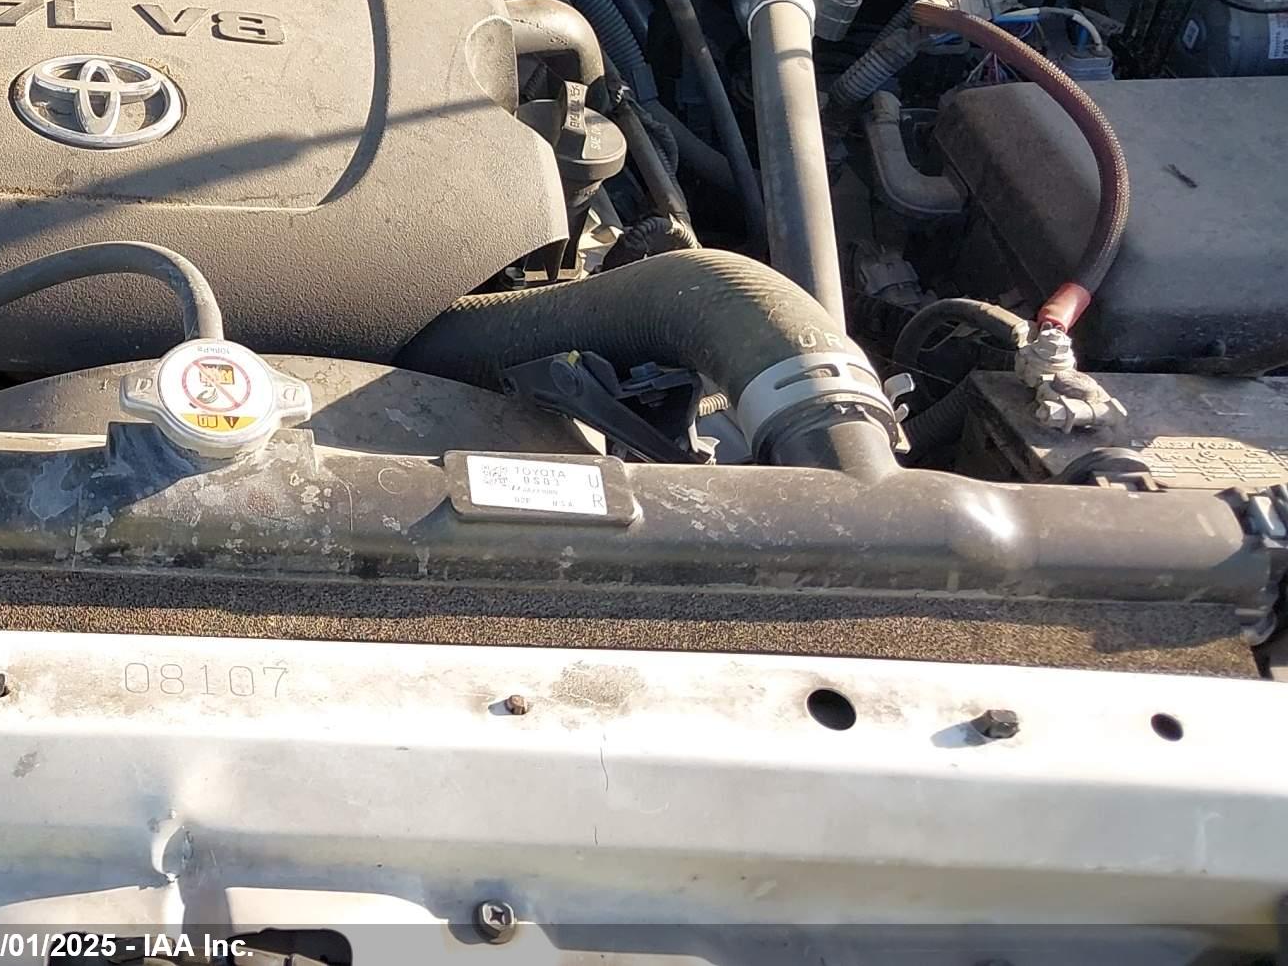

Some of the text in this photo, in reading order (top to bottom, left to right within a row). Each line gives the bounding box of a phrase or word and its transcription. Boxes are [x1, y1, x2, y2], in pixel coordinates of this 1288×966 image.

[131, 2, 286, 45] V8
[514, 466, 567, 478] TOYOTA
[124, 662, 289, 698] 08107
